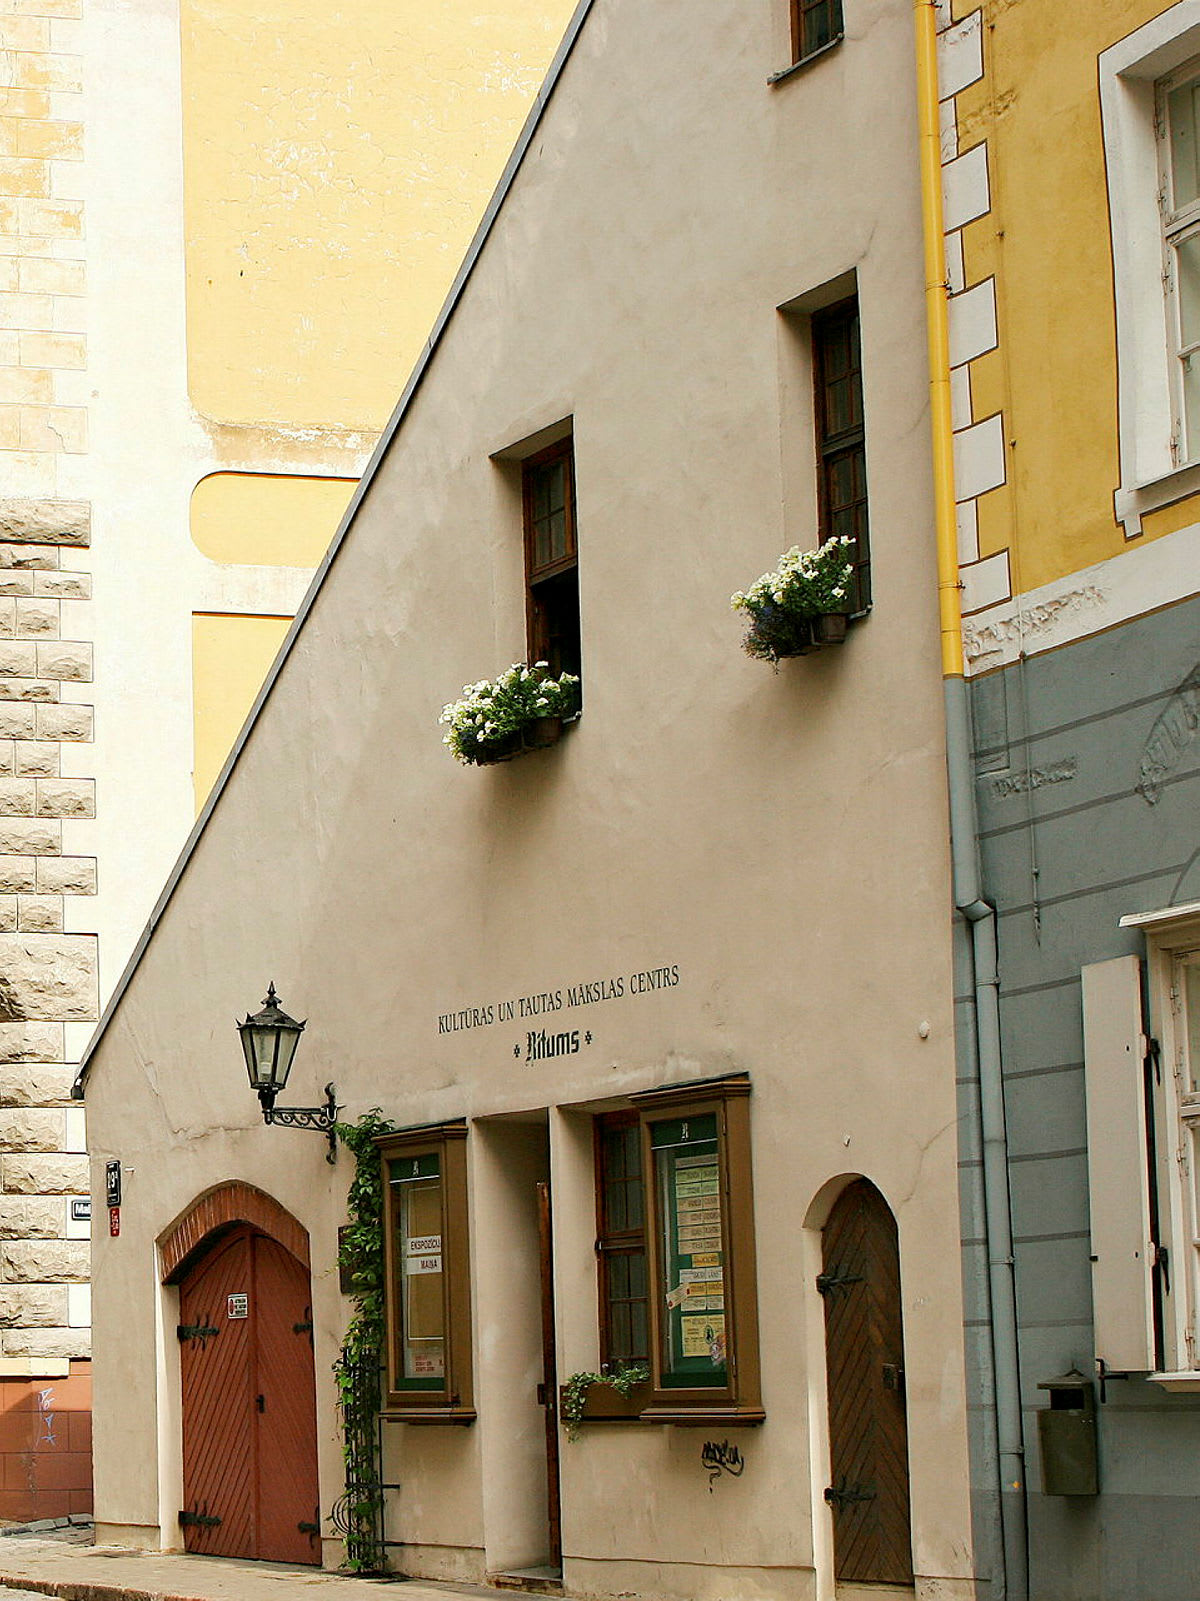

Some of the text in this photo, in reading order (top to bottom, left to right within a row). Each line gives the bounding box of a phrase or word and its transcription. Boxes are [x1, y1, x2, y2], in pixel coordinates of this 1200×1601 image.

[438, 964, 680, 1034] KULTŪRAS UN TAUTAS MĀKSLAS CENTRS
[525, 1028, 580, 1062] Ritums
